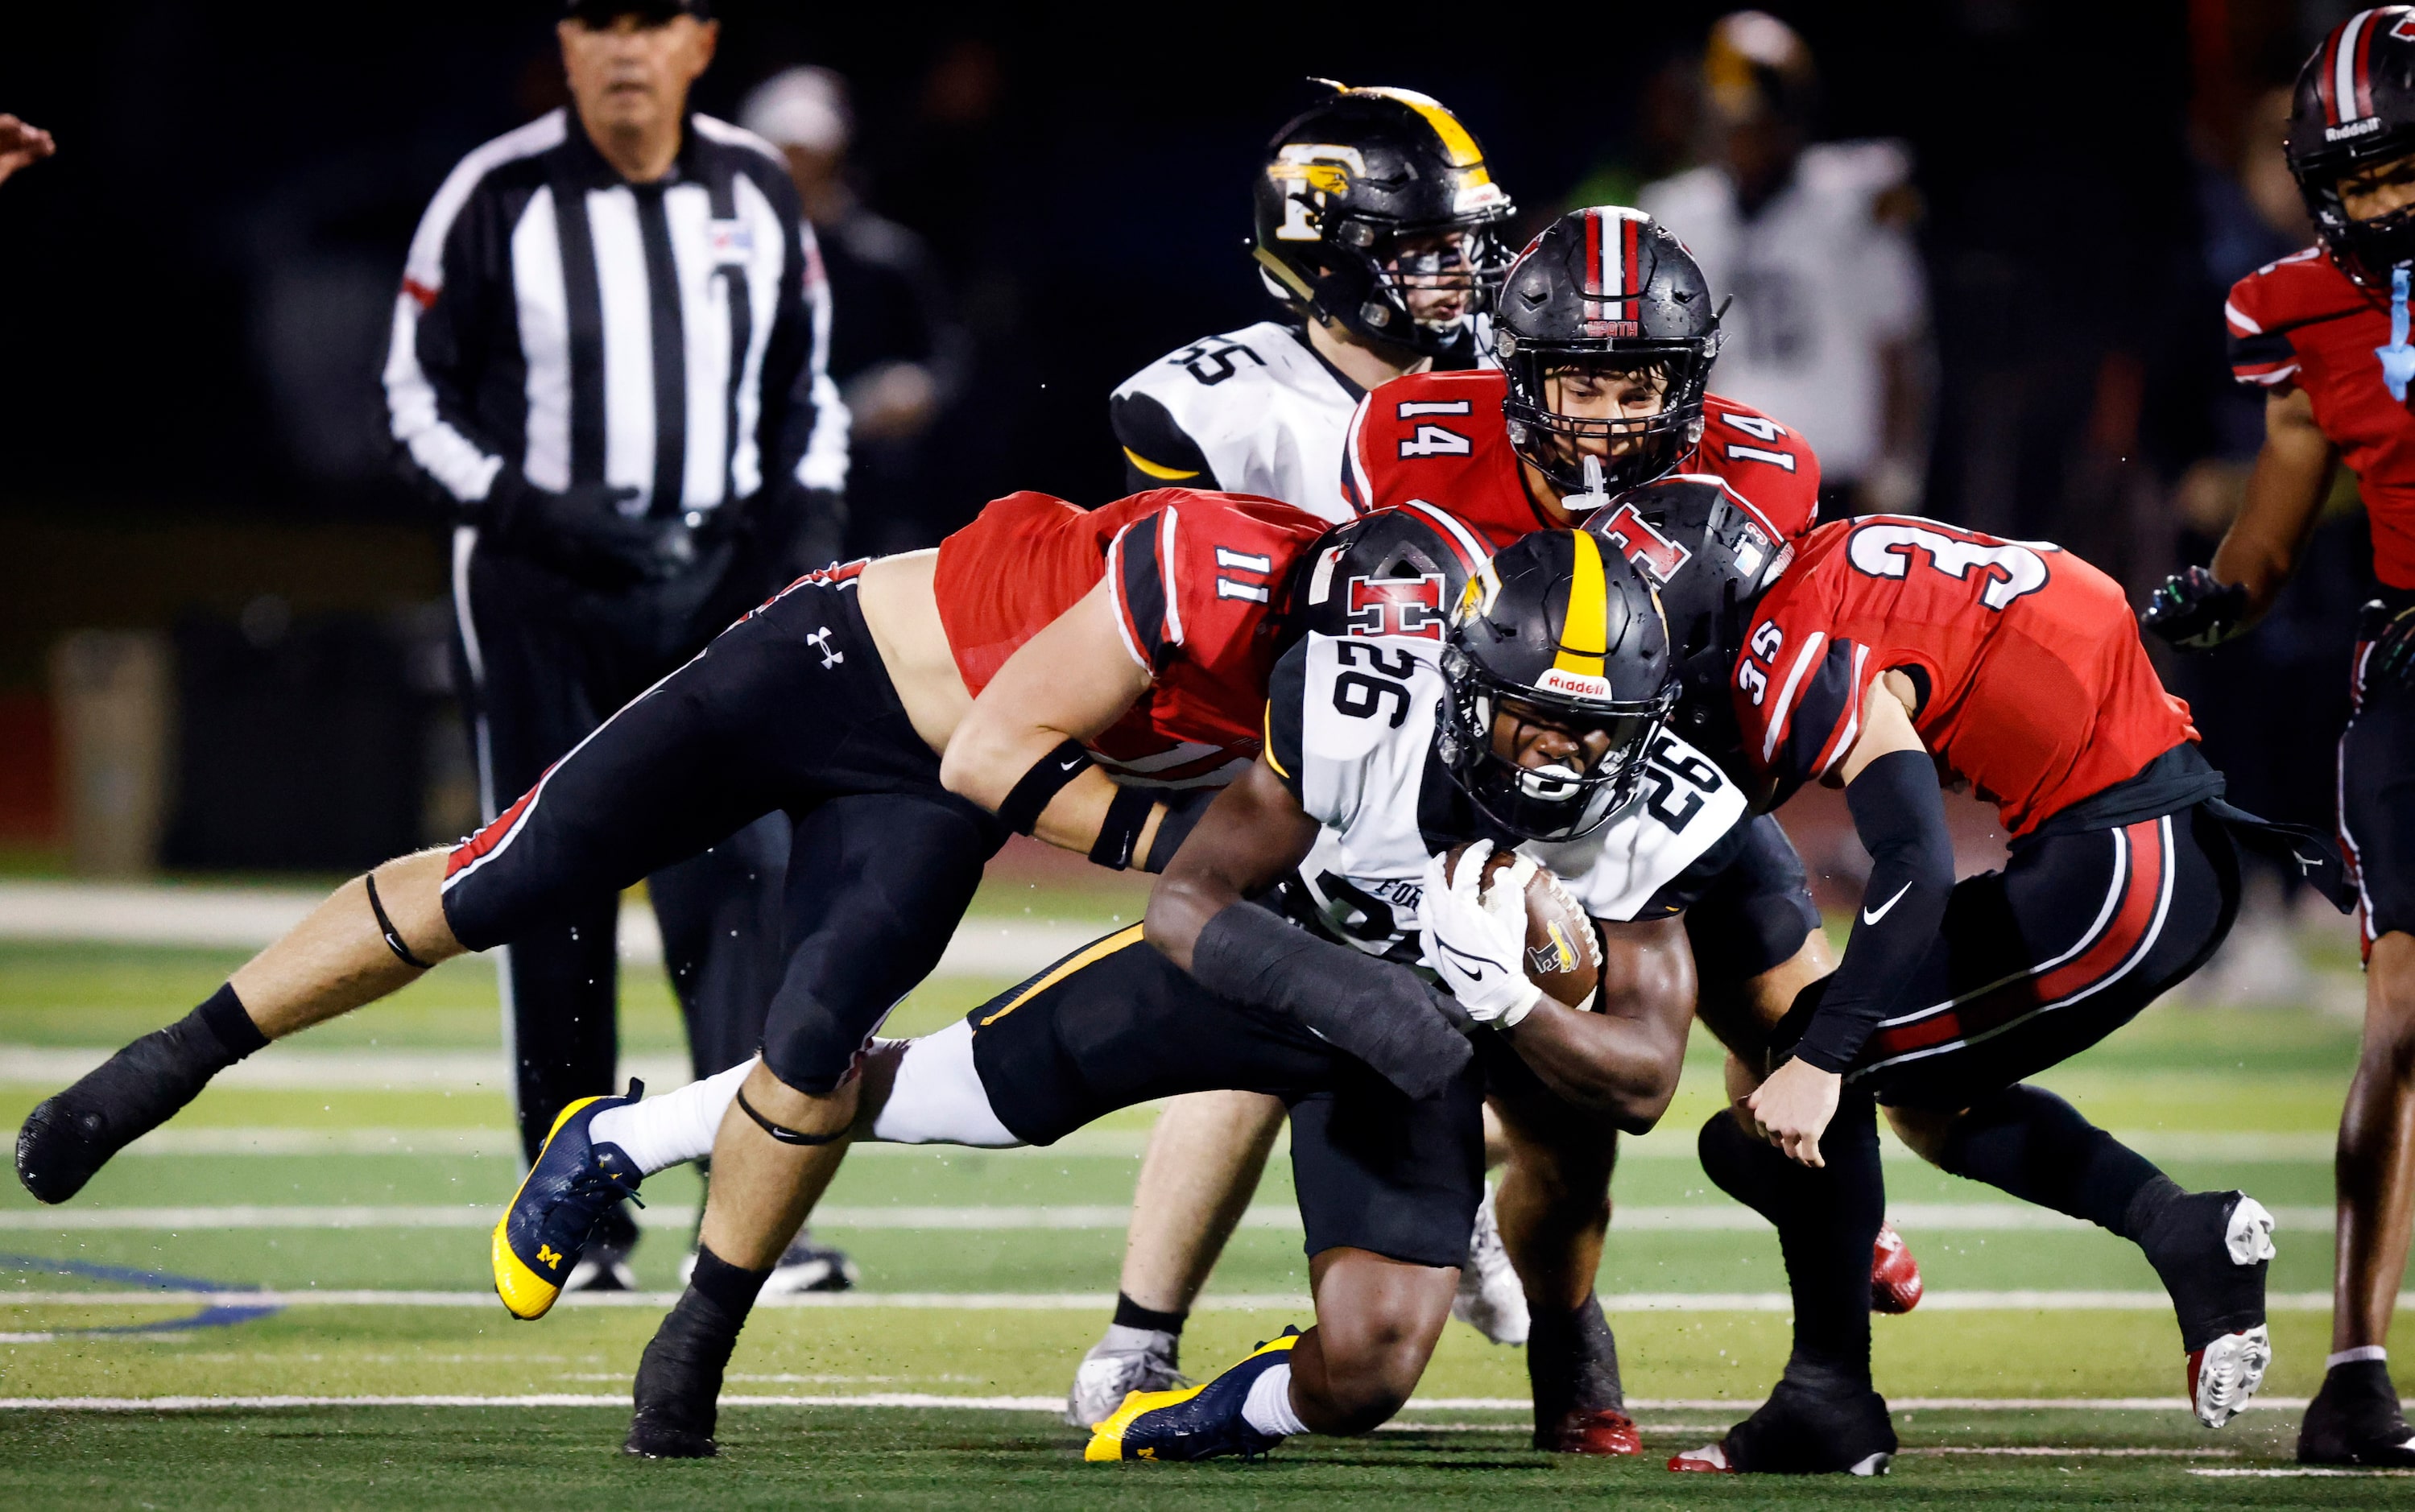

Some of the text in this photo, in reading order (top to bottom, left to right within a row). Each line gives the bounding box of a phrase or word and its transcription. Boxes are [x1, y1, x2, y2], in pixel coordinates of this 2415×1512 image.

[1167, 335, 1267, 386] 55
[1397, 399, 1473, 461] 14
[1720, 411, 1796, 474] 14
[1744, 522, 1768, 546] 3
[1214, 545, 1272, 605] 11
[1333, 640, 1414, 729] 26
[1549, 675, 1604, 696] Riddell
[1739, 618, 1784, 706] 35
[1646, 735, 1724, 837] 26
[1375, 877, 1424, 912] FOR
[536, 1243, 562, 1270] M
